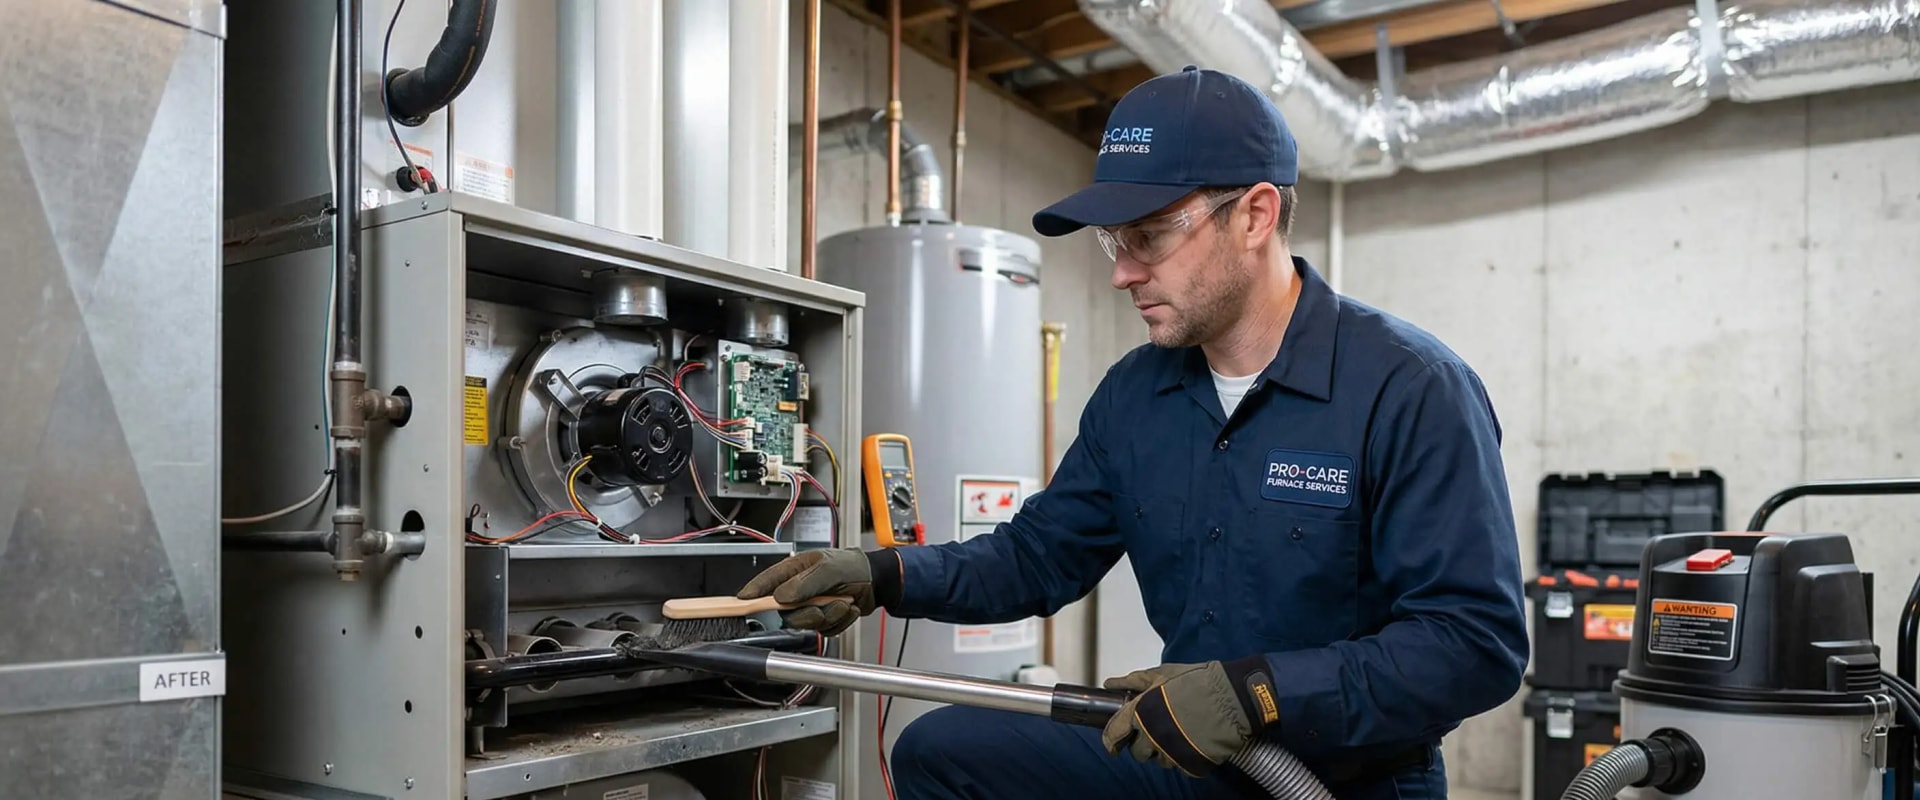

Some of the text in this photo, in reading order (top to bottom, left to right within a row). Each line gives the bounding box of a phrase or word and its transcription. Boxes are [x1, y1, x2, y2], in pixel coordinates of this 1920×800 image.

[1109, 144, 1151, 154] SERVICES
[1268, 462, 1350, 484] PRO-CARE
[1266, 477, 1347, 495] FURNACE SERVICES
[1672, 604, 1717, 616] WANTING
[154, 670, 211, 690] AFTER
